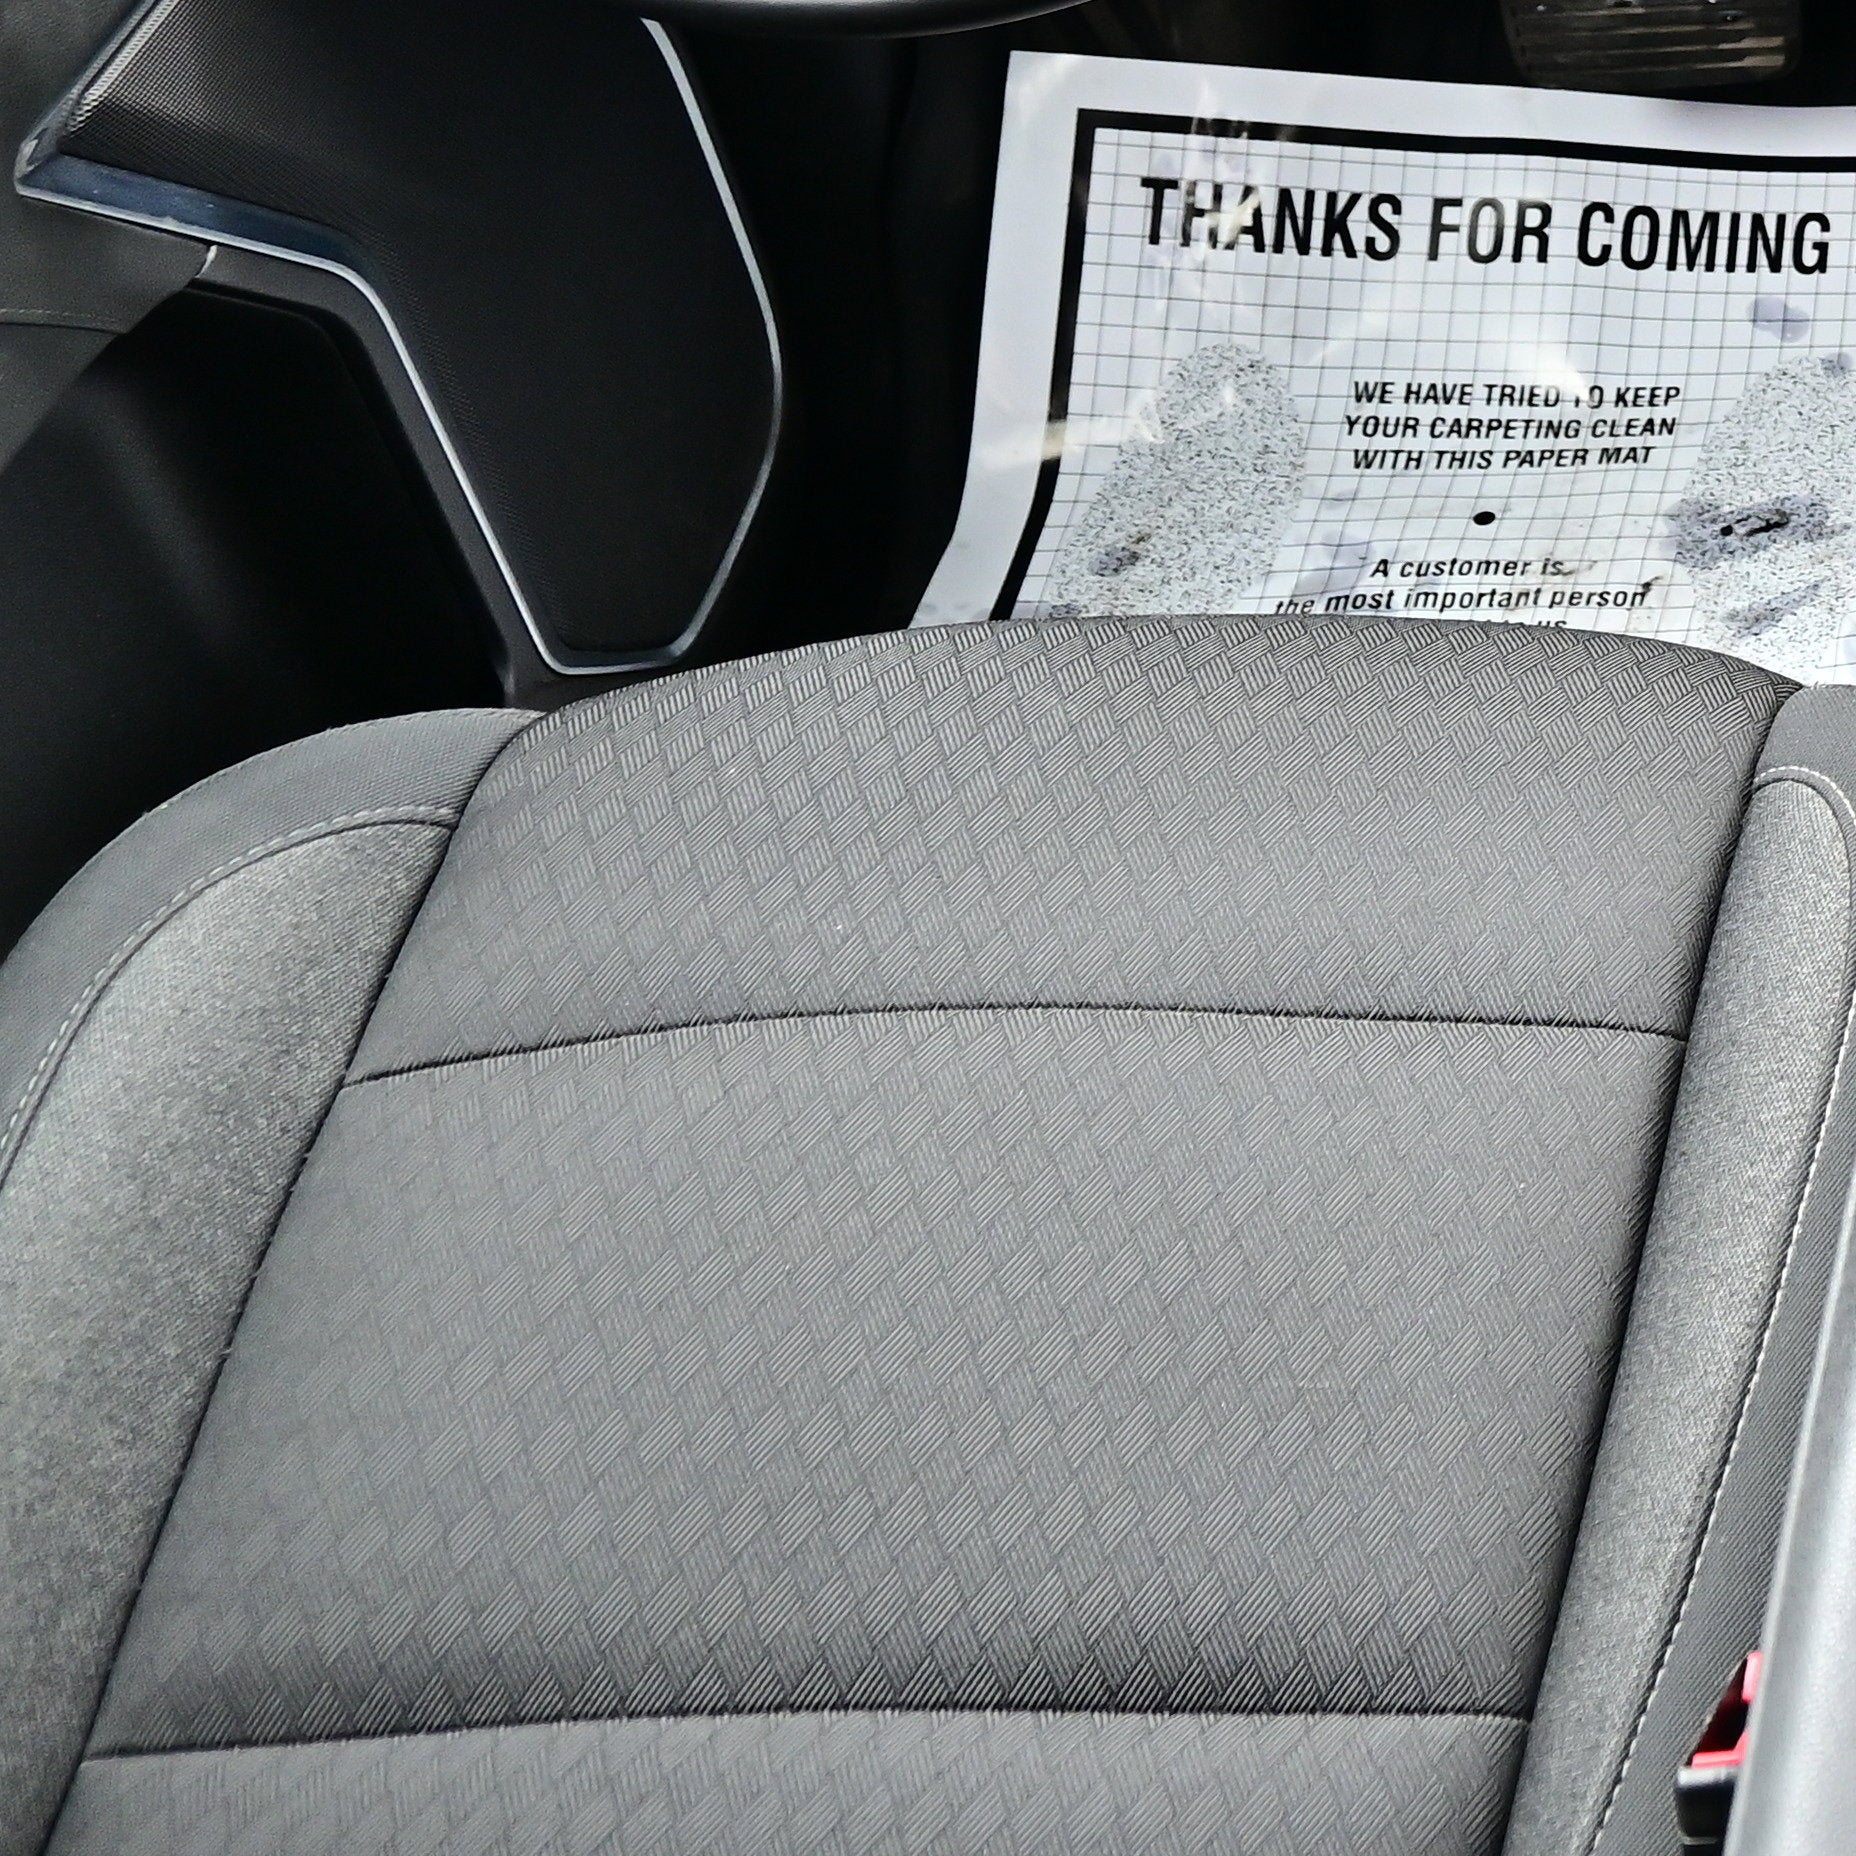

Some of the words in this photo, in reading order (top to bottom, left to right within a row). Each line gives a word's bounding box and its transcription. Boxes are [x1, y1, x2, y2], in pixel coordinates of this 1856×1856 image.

[1140, 177, 1403, 262] THANKS
[1427, 196, 1553, 264] FOR
[1577, 201, 1832, 274] COMING
[1353, 381, 1395, 405] WE
[1403, 382, 1474, 406] HAVE
[1482, 383, 1561, 408] TRIED
[1613, 386, 1681, 408] KEEP
[1344, 415, 1420, 439] YOUR
[1428, 416, 1582, 439] CARPETING
[1590, 417, 1677, 438] CLEAN
[1352, 448, 1426, 470] WITH
[1433, 449, 1493, 470] THIS
[1502, 446, 1589, 469] PAPER
[1598, 445, 1656, 466] MAT
[1370, 558, 1390, 578] A
[1400, 557, 1532, 578] customer
[1274, 598, 1316, 616] the
[1325, 589, 1395, 612] most
[1404, 587, 1541, 612] important
[1548, 588, 1647, 610] person
